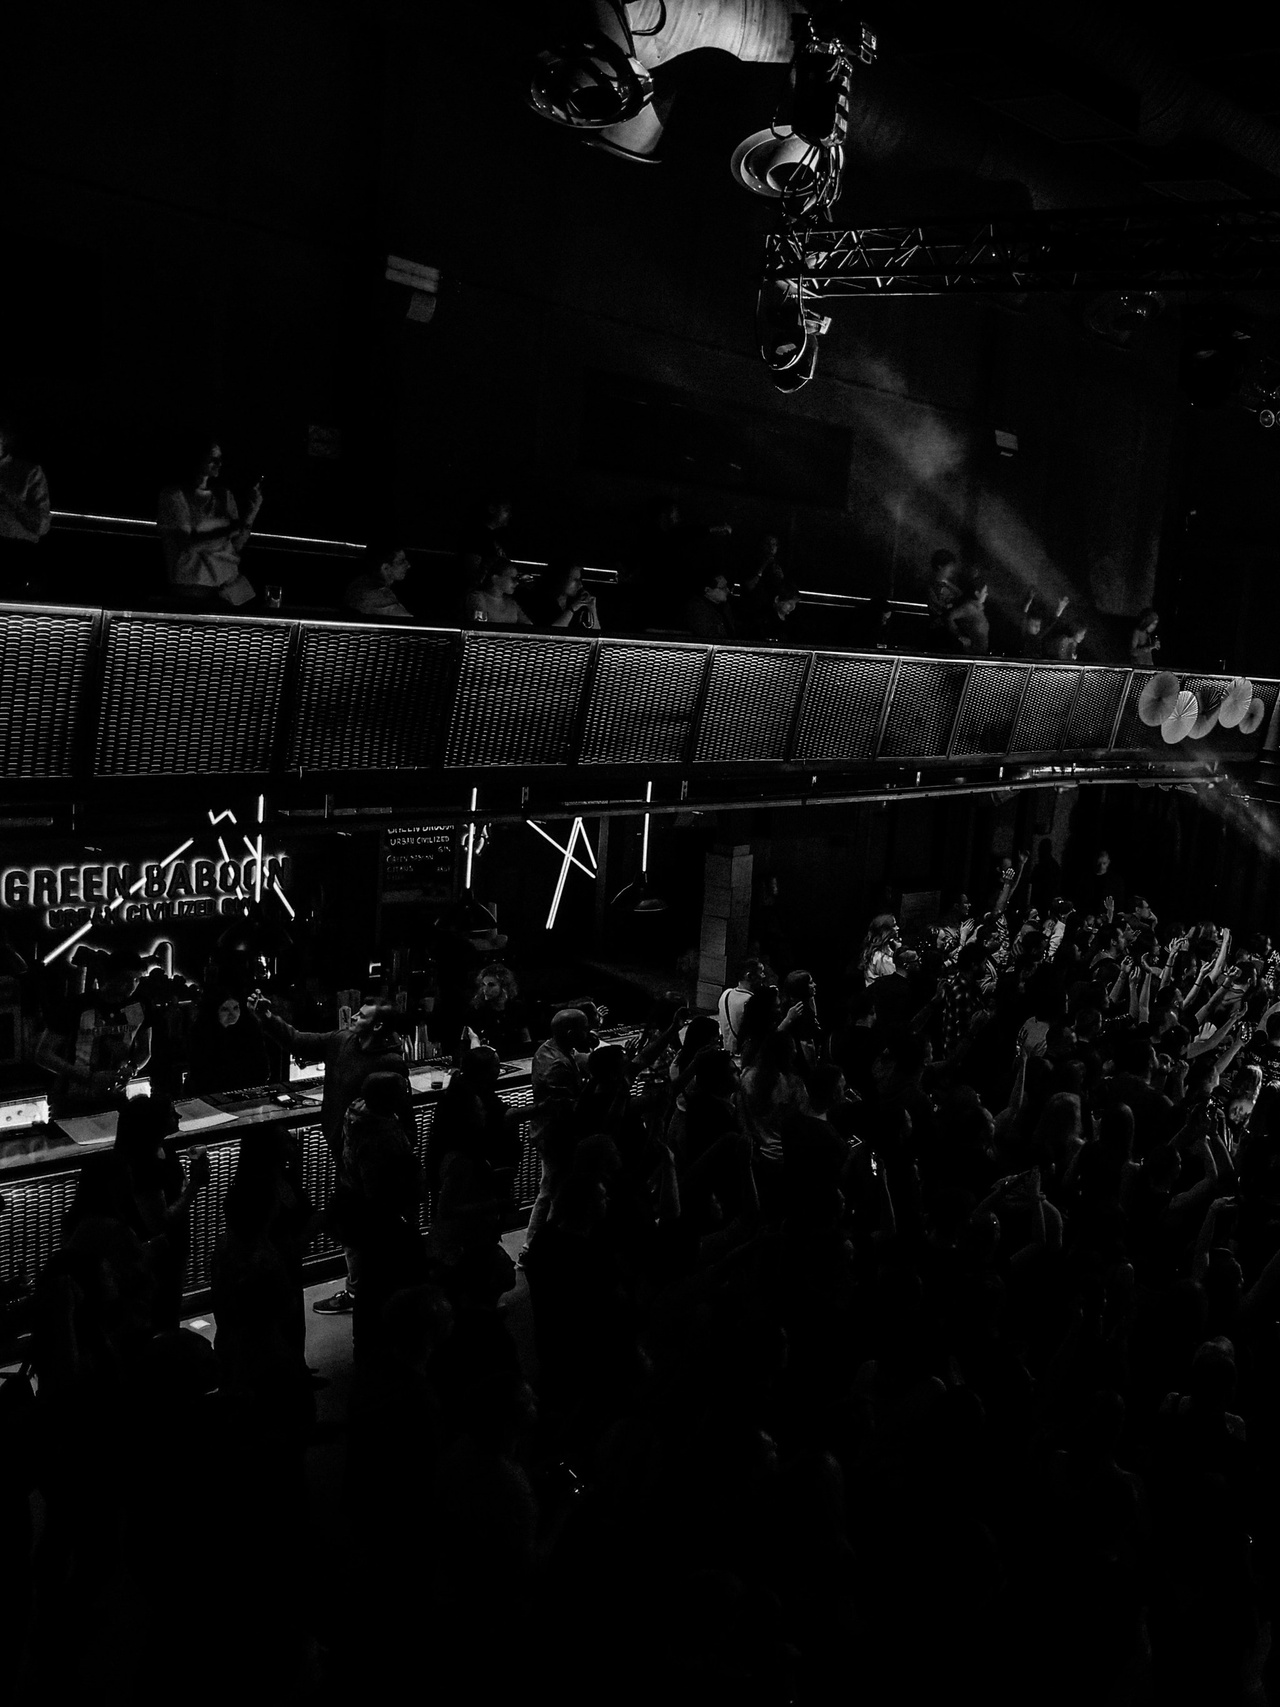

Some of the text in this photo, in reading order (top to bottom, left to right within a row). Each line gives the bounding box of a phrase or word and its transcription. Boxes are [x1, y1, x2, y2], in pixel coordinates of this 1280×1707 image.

[3, 856, 292, 907] GREEN BABOON
[47, 906, 121, 929] URBAN
[126, 899, 217, 922] CIVILIZED
